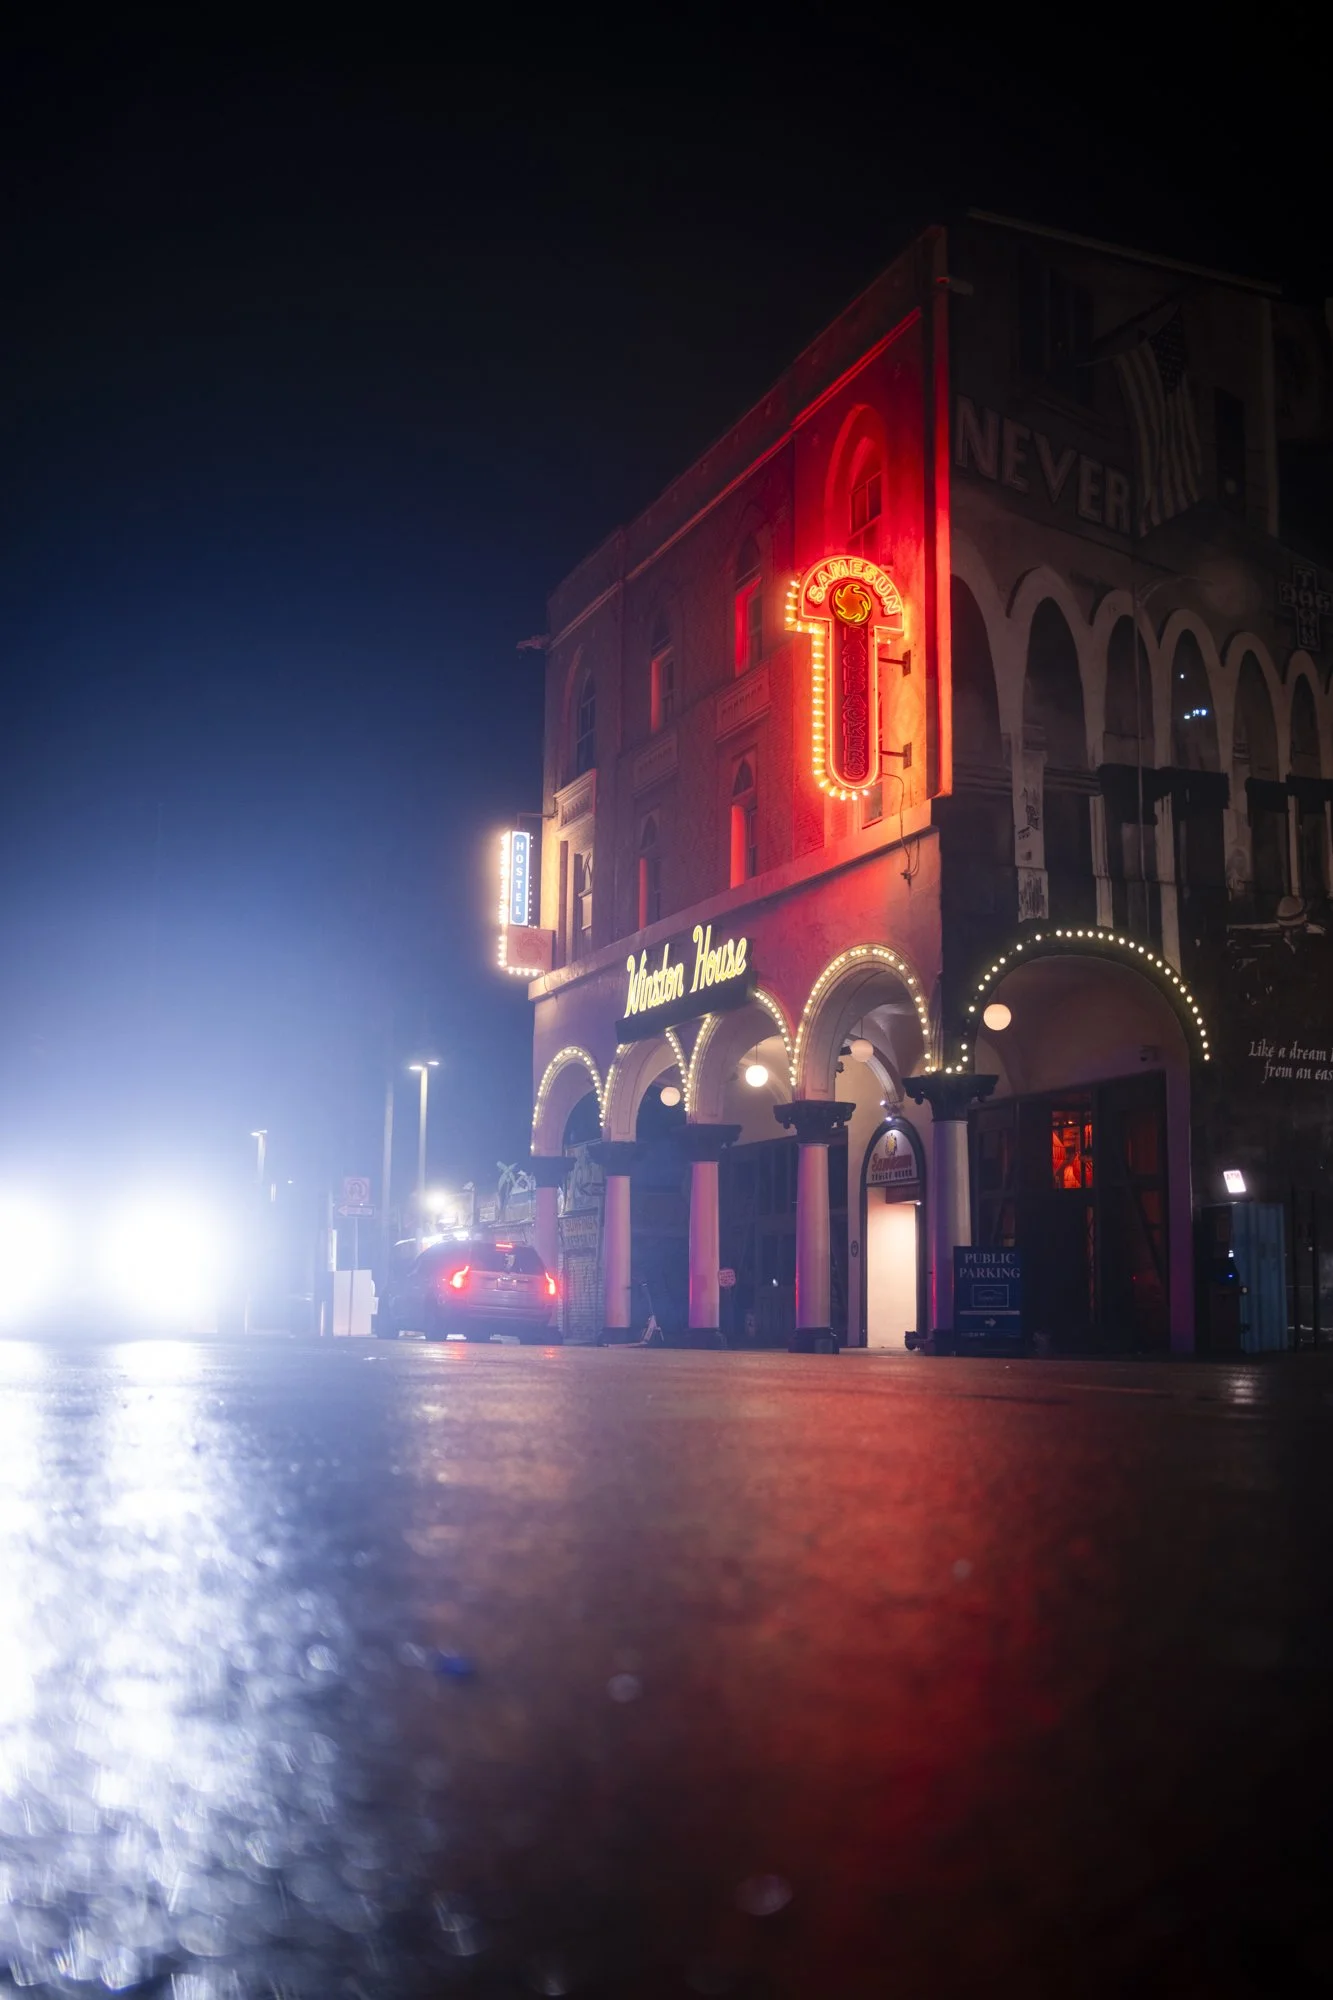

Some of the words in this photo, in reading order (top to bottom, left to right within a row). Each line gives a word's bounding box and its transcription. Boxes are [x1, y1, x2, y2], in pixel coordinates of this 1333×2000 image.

[954, 394, 1131, 534] NEVER
[807, 558, 902, 616] SAMESUN
[841, 626, 868, 780] BACKPACKERS
[515, 841, 525, 916] HOSTEL
[623, 942, 685, 1019] Winston
[689, 924, 748, 994] House
[1248, 1038, 1275, 1058] Like
[1278, 1046, 1286, 1058] a
[1289, 1040, 1327, 1061] dream
[1260, 1058, 1293, 1084] from
[1295, 1066, 1312, 1080] an
[959, 1267, 1021, 1279] PARKING
[964, 1252, 1016, 1265] PUBLIC
